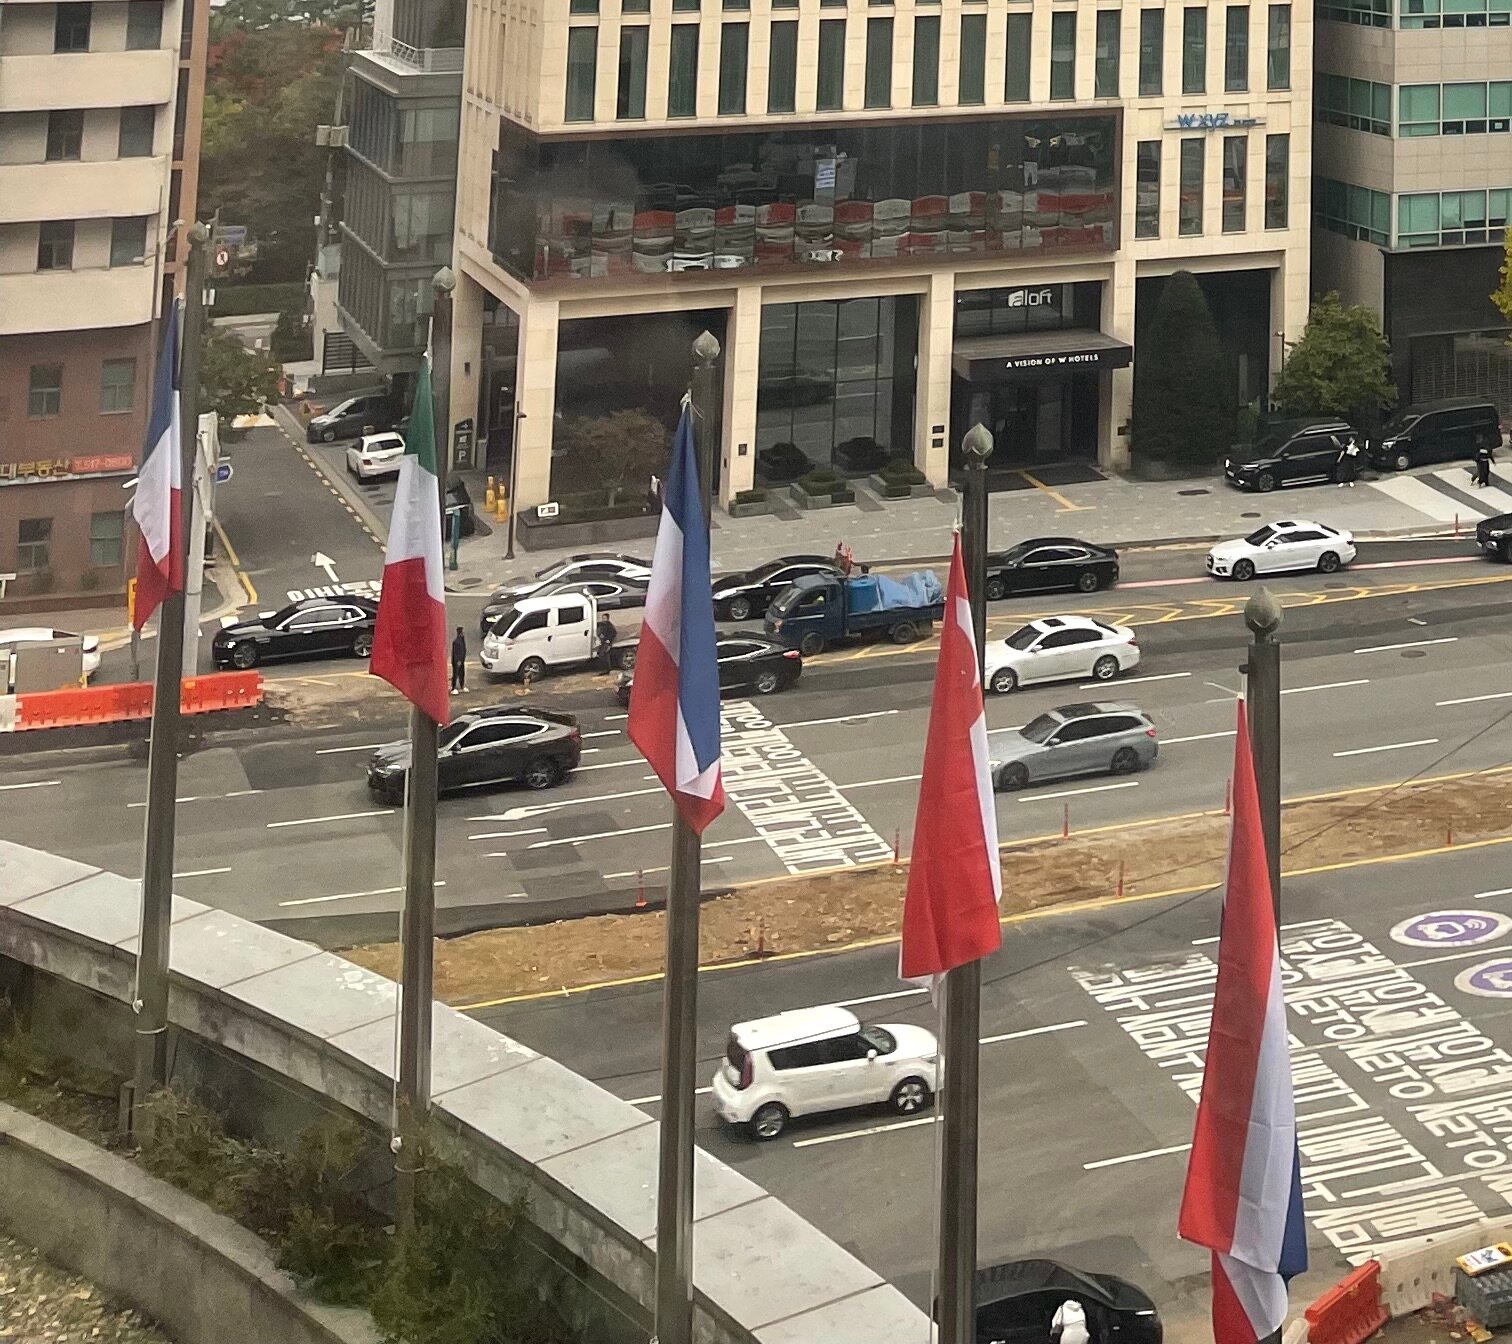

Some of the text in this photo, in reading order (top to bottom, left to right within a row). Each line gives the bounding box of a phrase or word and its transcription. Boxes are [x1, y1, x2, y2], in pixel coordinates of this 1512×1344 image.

[1008, 289, 1052, 307] aloft
[1015, 359, 1042, 367] VISION
[1068, 354, 1099, 363] HOTELS
[459, 451, 466, 462] P
